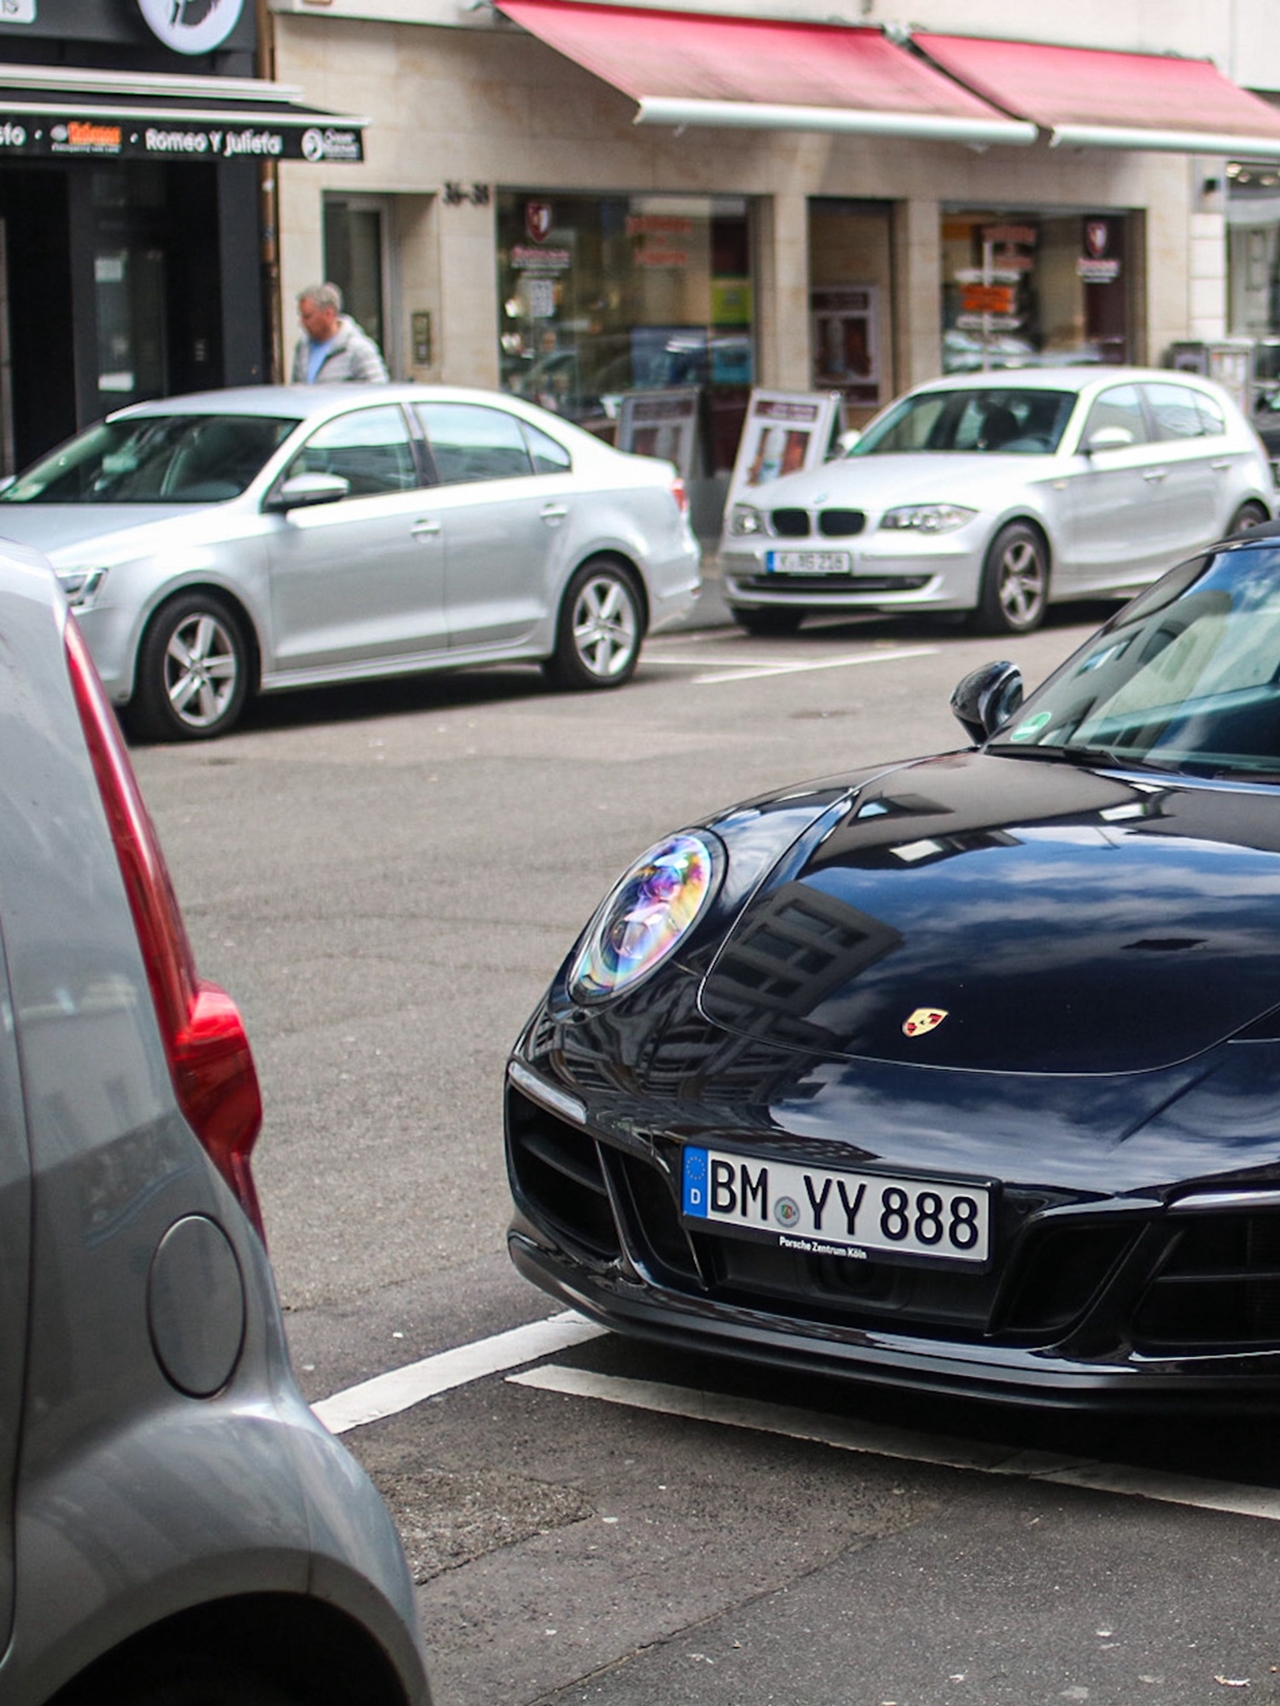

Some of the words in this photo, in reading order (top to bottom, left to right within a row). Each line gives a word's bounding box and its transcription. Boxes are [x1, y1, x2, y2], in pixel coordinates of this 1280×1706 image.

[145, 128, 208, 152] Romeo
[209, 130, 223, 153] Y
[223, 129, 283, 158] Julieta
[690, 1188, 701, 1205] D
[710, 1159, 768, 1221] BM
[803, 1174, 867, 1235] YY
[880, 1186, 979, 1250] 888
[779, 1235, 812, 1251] Porsche
[811, 1241, 847, 1257] Zentrum
[847, 1246, 868, 1260] Köln
